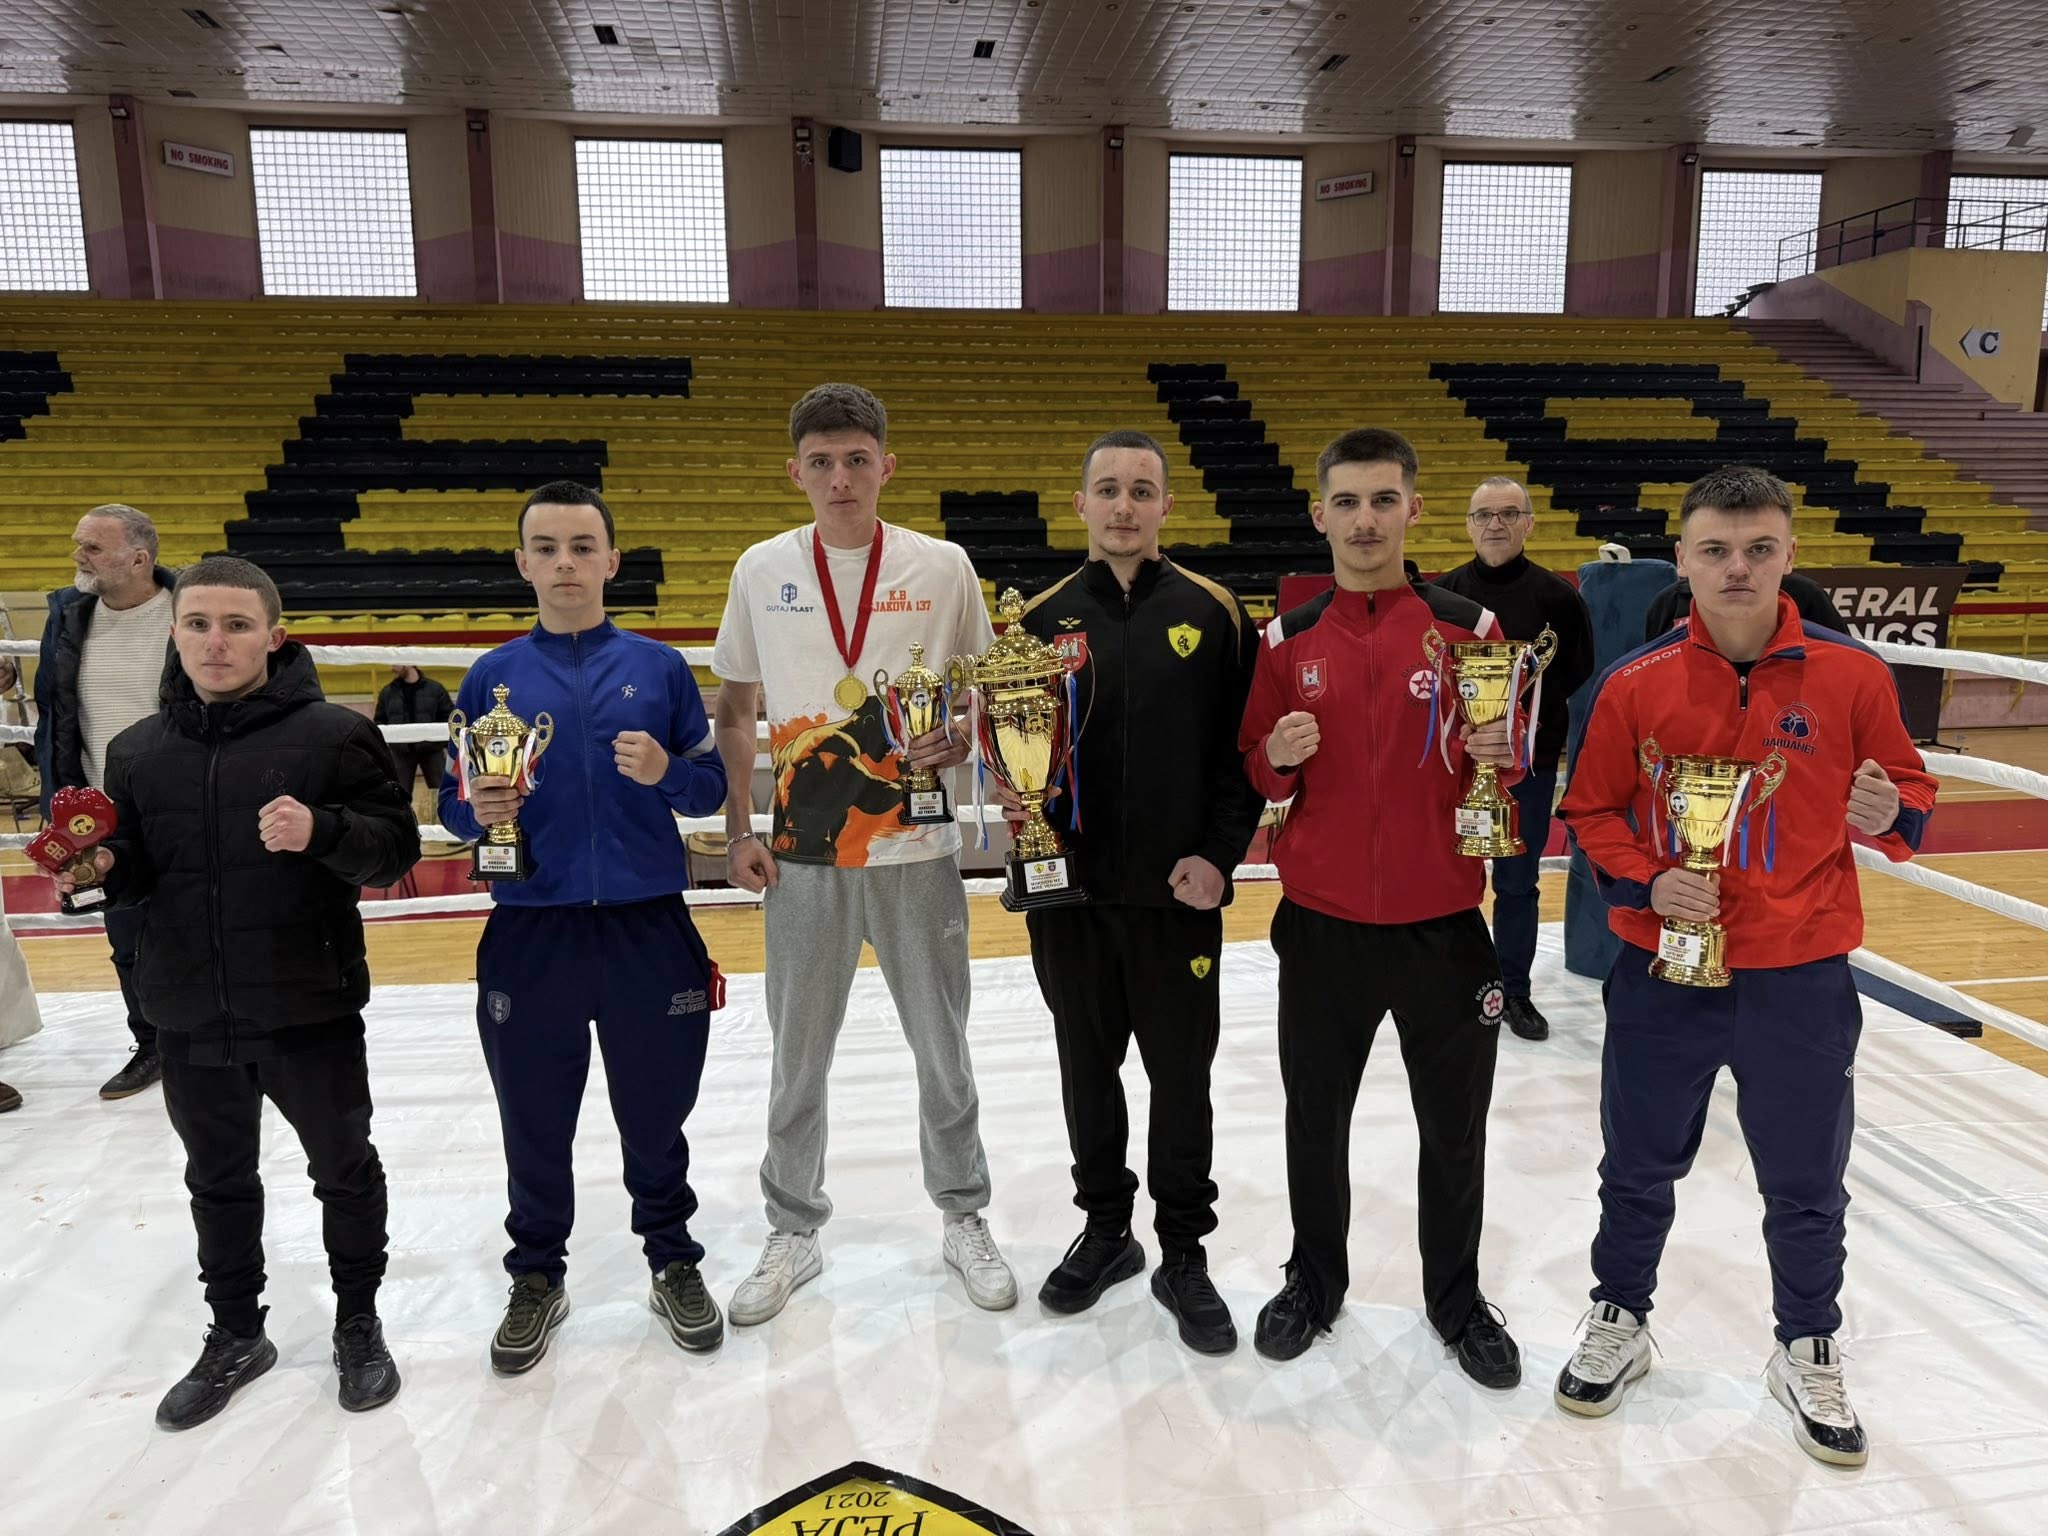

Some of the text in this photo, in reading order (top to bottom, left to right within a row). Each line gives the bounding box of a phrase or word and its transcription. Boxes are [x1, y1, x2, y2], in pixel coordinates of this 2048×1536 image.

[170, 148, 229, 170] NO SMOKING
[1320, 178, 1367, 194] NO SMOKING
[1979, 331, 1999, 354] C
[916, 600, 931, 611] 137
[1824, 586, 1939, 618] ERAL
[1622, 647, 1682, 677] DAFRON
[825, 1490, 891, 1510] 2021
